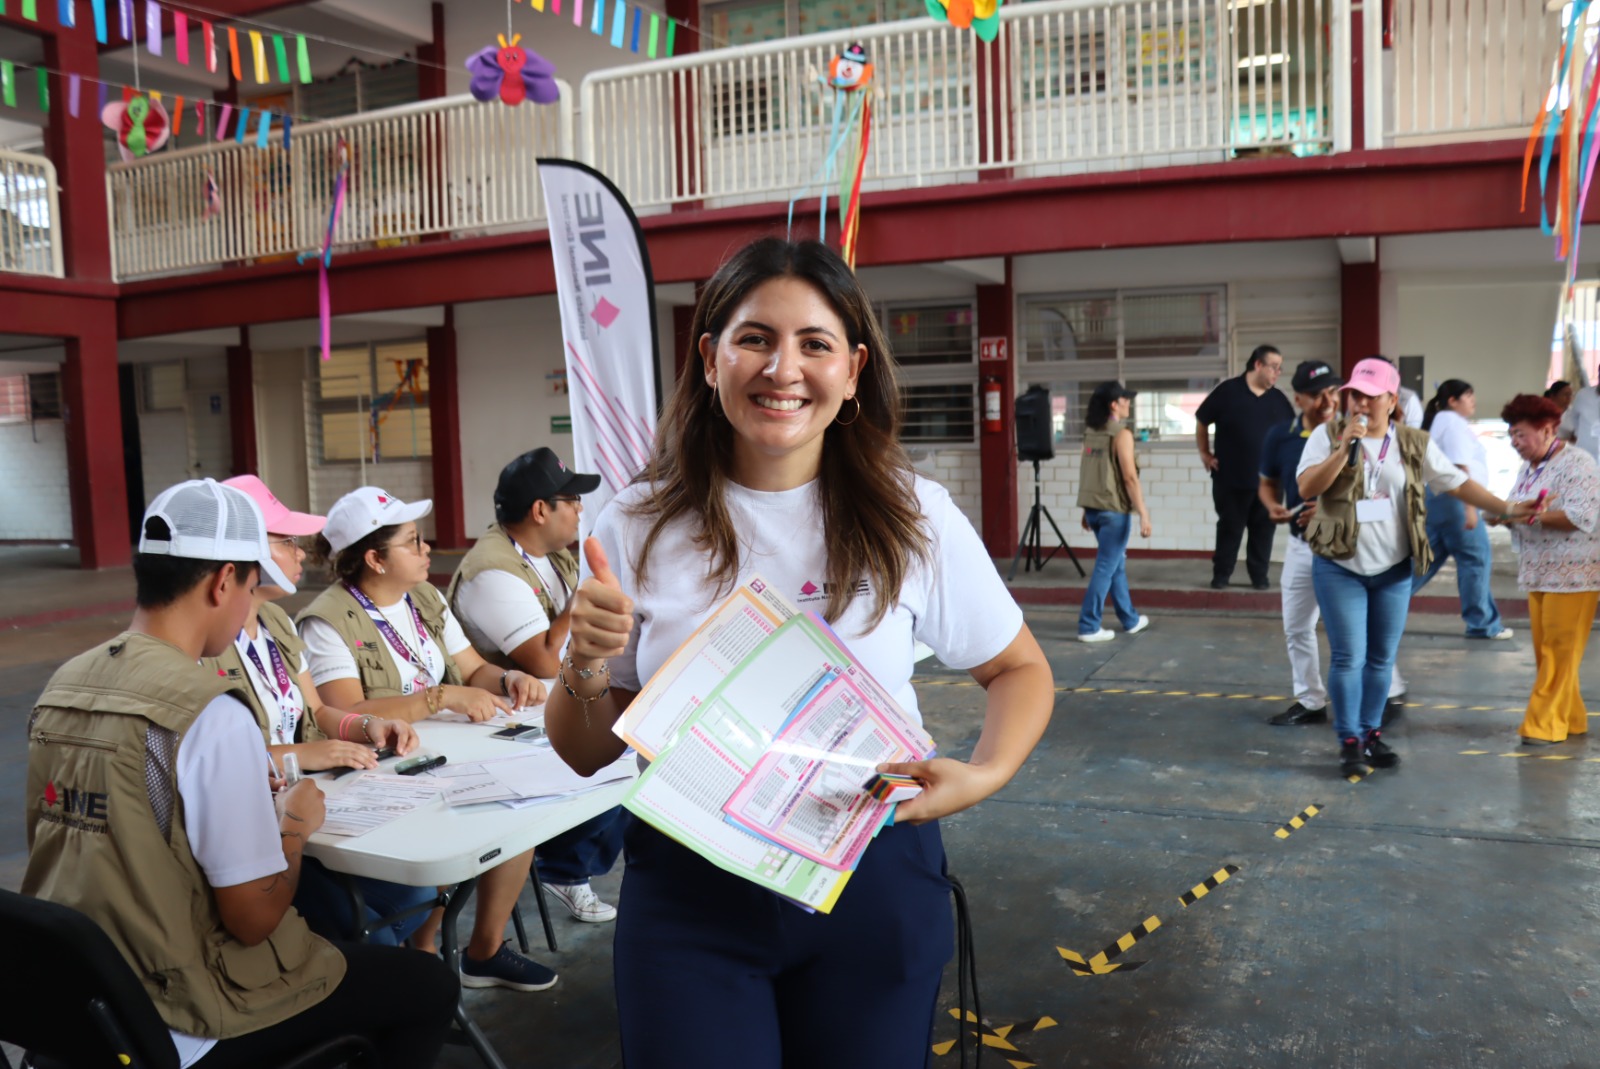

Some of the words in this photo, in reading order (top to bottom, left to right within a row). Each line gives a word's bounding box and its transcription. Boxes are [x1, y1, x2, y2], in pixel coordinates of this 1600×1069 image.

[823, 579, 869, 594] IE
[381, 624, 406, 654] TABASCO
[270, 647, 288, 685] TABASCO
[63, 786, 108, 821] INE
